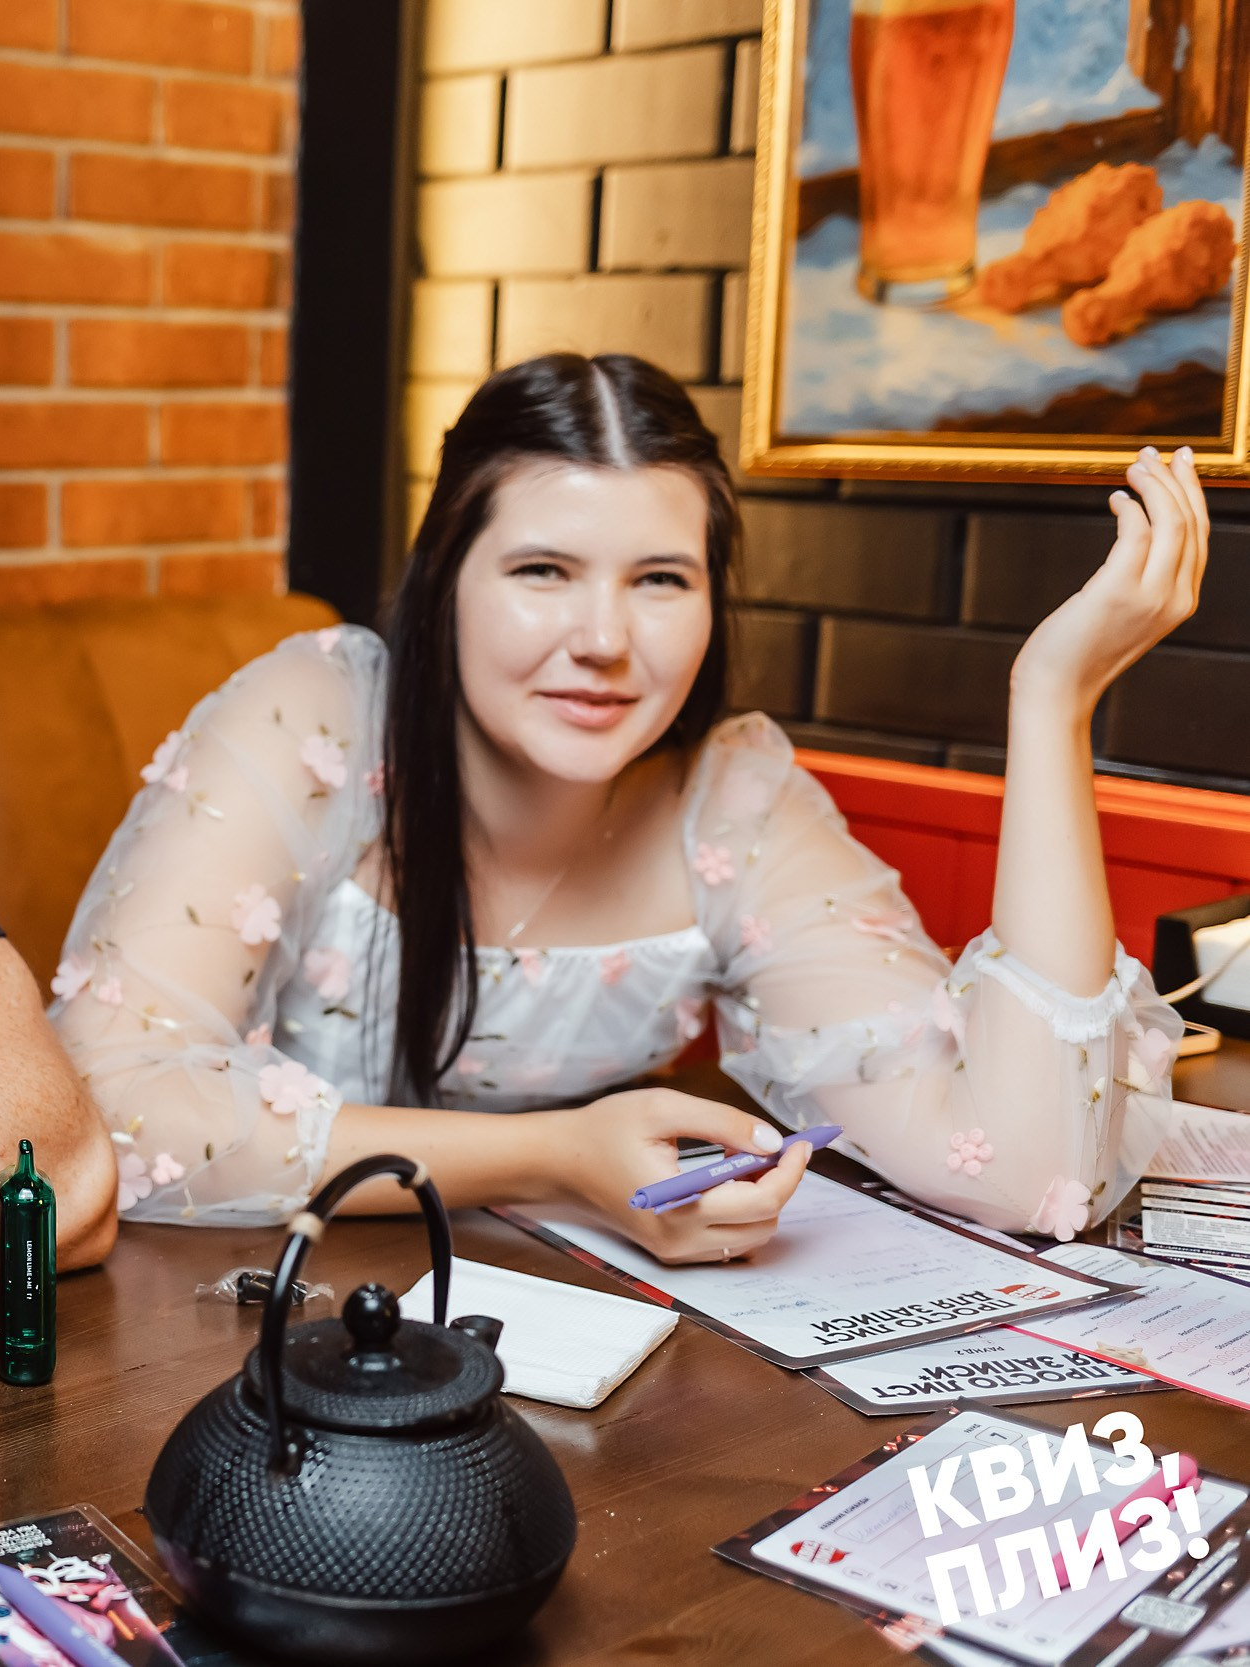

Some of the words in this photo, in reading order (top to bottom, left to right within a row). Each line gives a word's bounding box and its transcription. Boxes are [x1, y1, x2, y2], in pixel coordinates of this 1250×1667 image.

[930, 1290, 995, 1309] ДЛЯ
[810, 1303, 923, 1333] ЗАПИСИ
[896, 1300, 1018, 1329] ПРОСТО
[813, 1322, 895, 1345] ЛИСТ
[871, 1378, 965, 1398] ЛИСТ
[968, 1365, 1112, 1388] ПРОСТО
